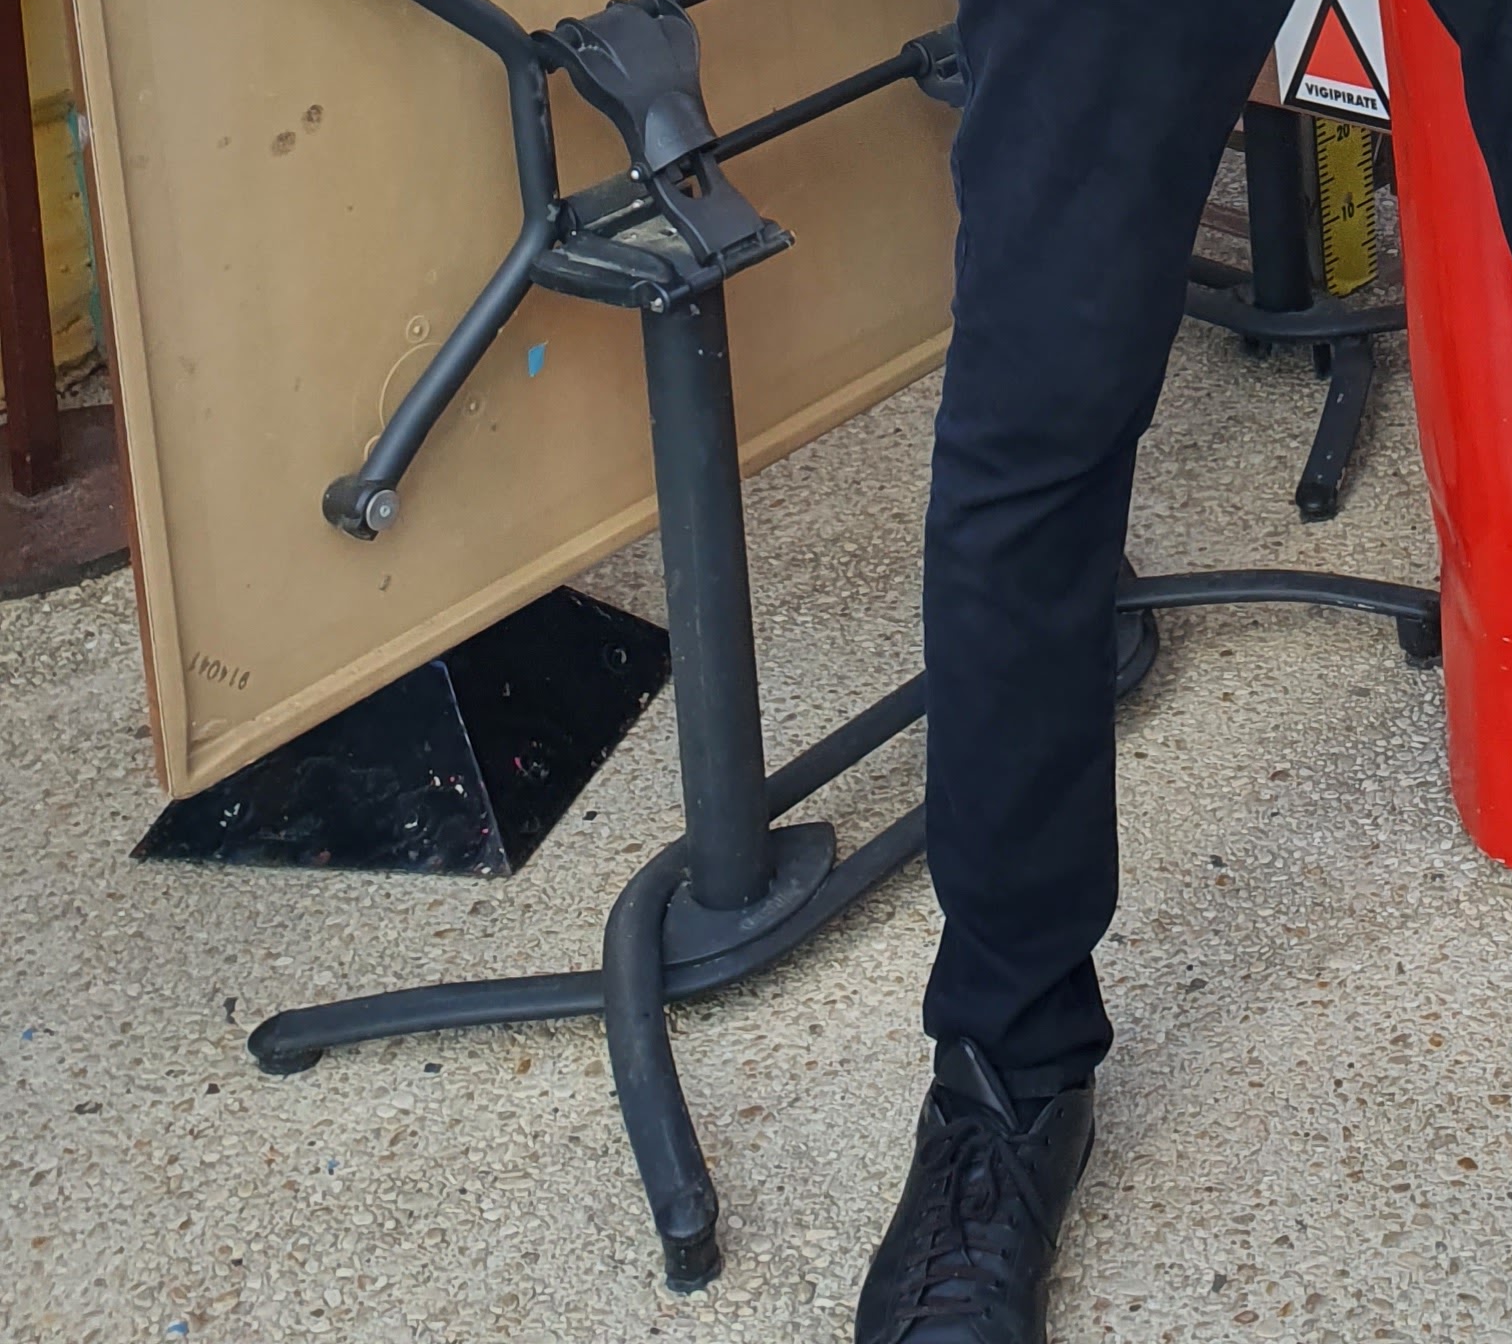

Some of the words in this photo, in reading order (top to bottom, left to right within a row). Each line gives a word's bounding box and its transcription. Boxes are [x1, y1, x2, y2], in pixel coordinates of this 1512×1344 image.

[1304, 82, 1378, 111] VIGIPIRATE
[1336, 123, 1351, 142] 20
[1341, 201, 1355, 222] 10
